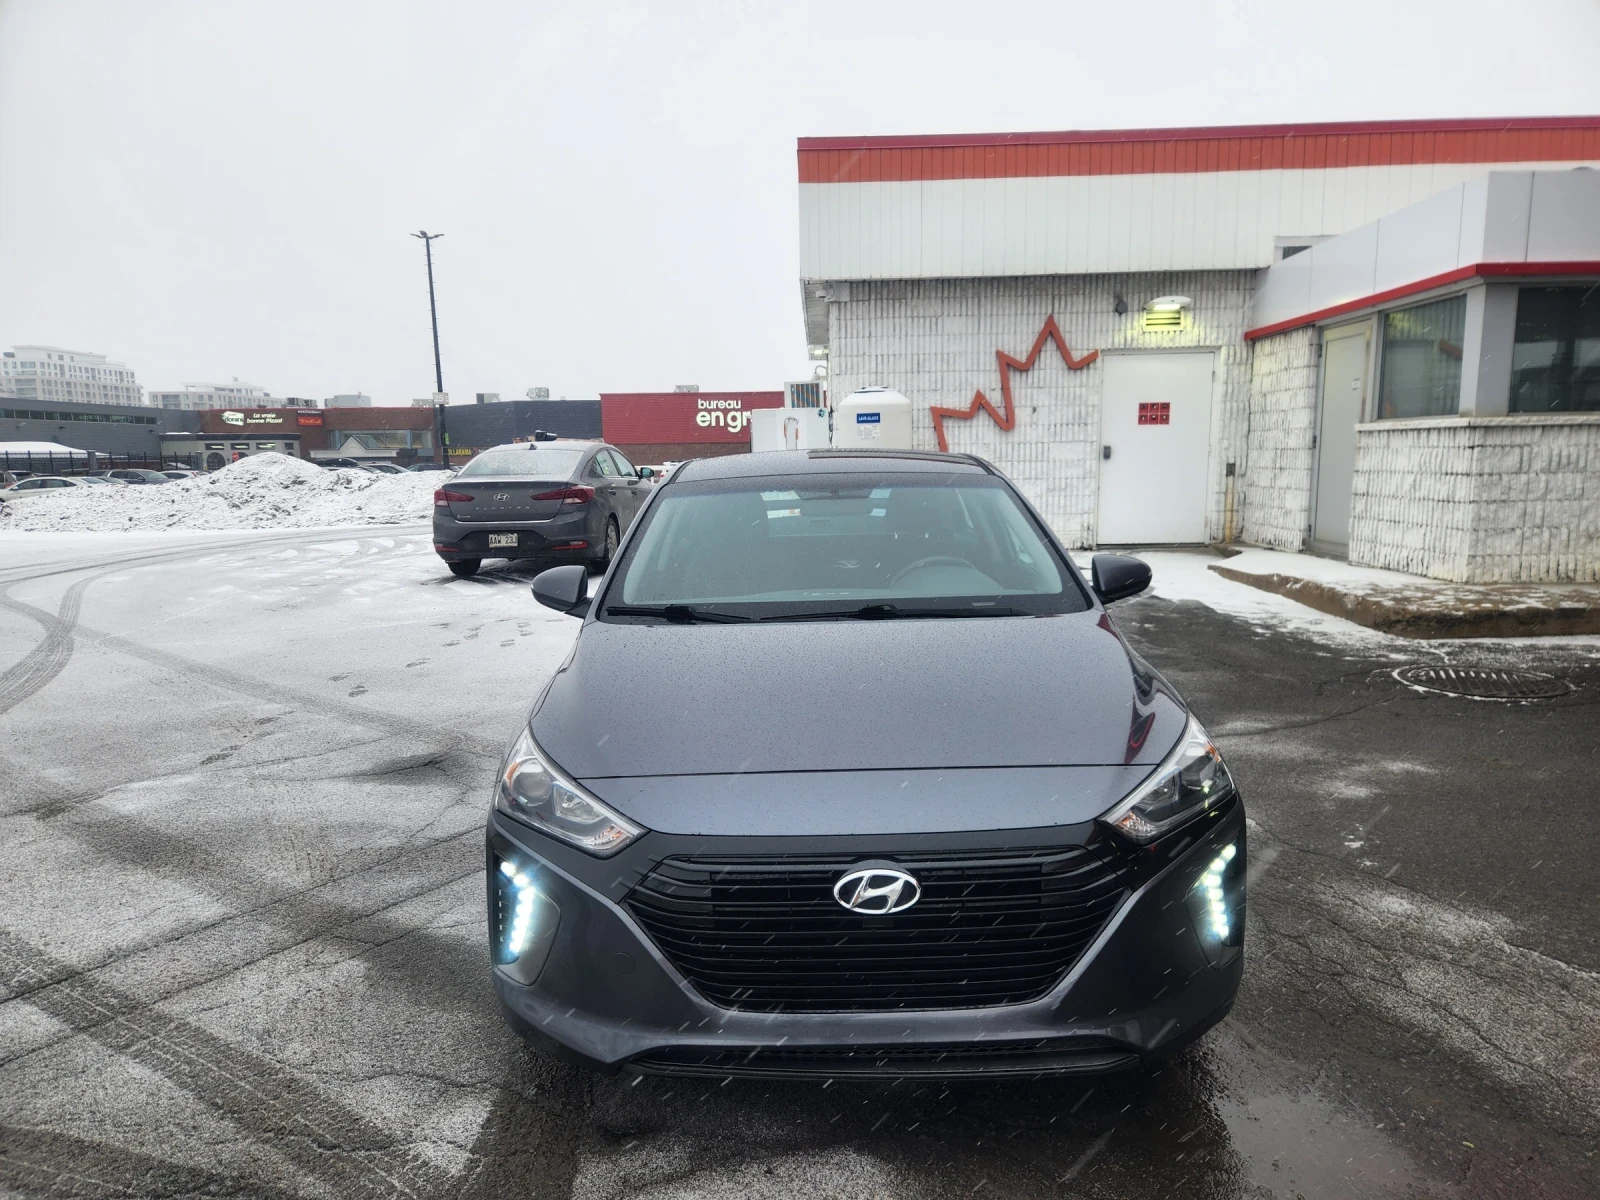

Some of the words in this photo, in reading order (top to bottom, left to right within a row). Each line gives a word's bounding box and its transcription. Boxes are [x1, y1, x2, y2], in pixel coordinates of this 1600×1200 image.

[698, 398, 741, 409] bureau
[696, 411, 725, 427] en
[727, 411, 752, 432] gr
[448, 448, 473, 456] OLLARAMA
